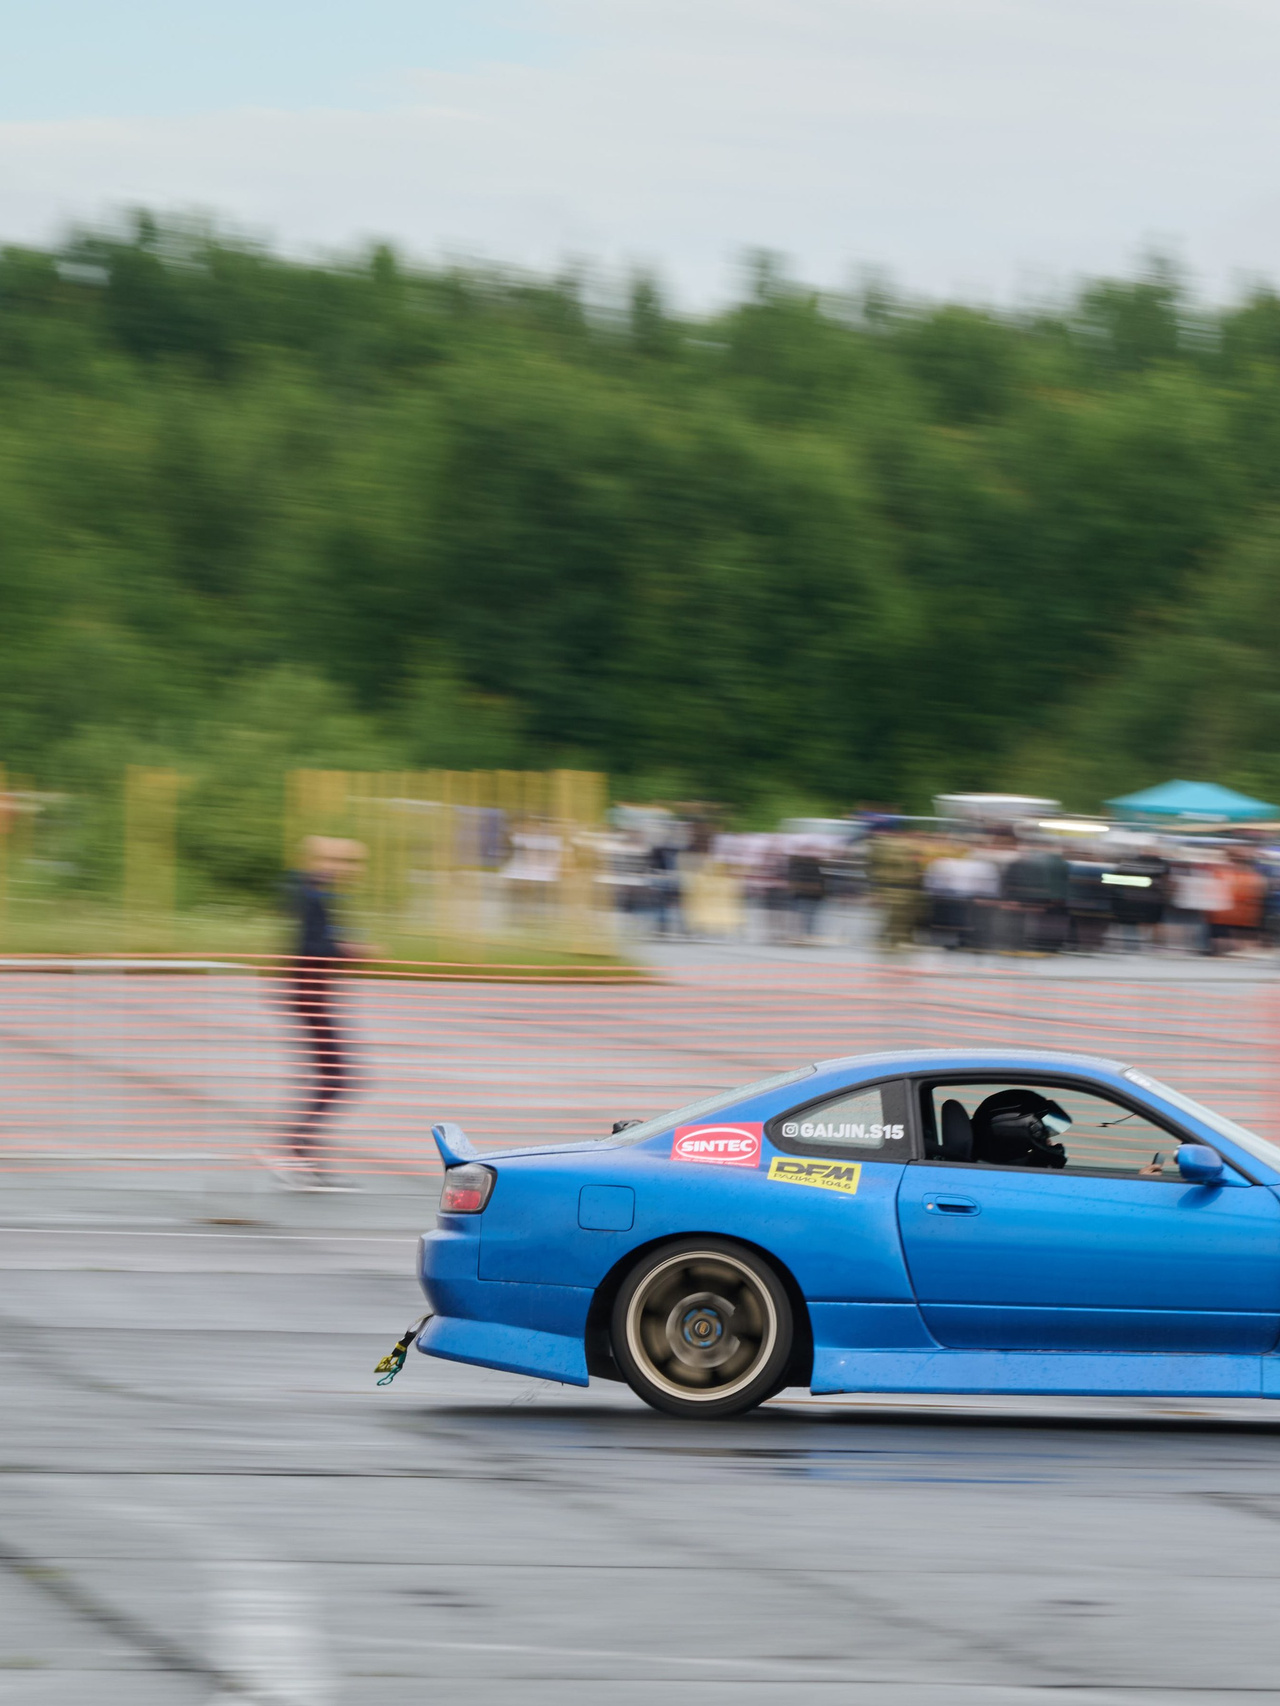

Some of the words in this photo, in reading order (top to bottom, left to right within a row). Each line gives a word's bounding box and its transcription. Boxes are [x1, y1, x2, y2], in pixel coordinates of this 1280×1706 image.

[800, 1123, 904, 1139] GAIJIN.S15
[681, 1140, 752, 1152] SINTEC
[776, 1162, 855, 1181] DFM
[773, 1173, 817, 1184] РАДИО
[820, 1180, 851, 1190] 104.6
